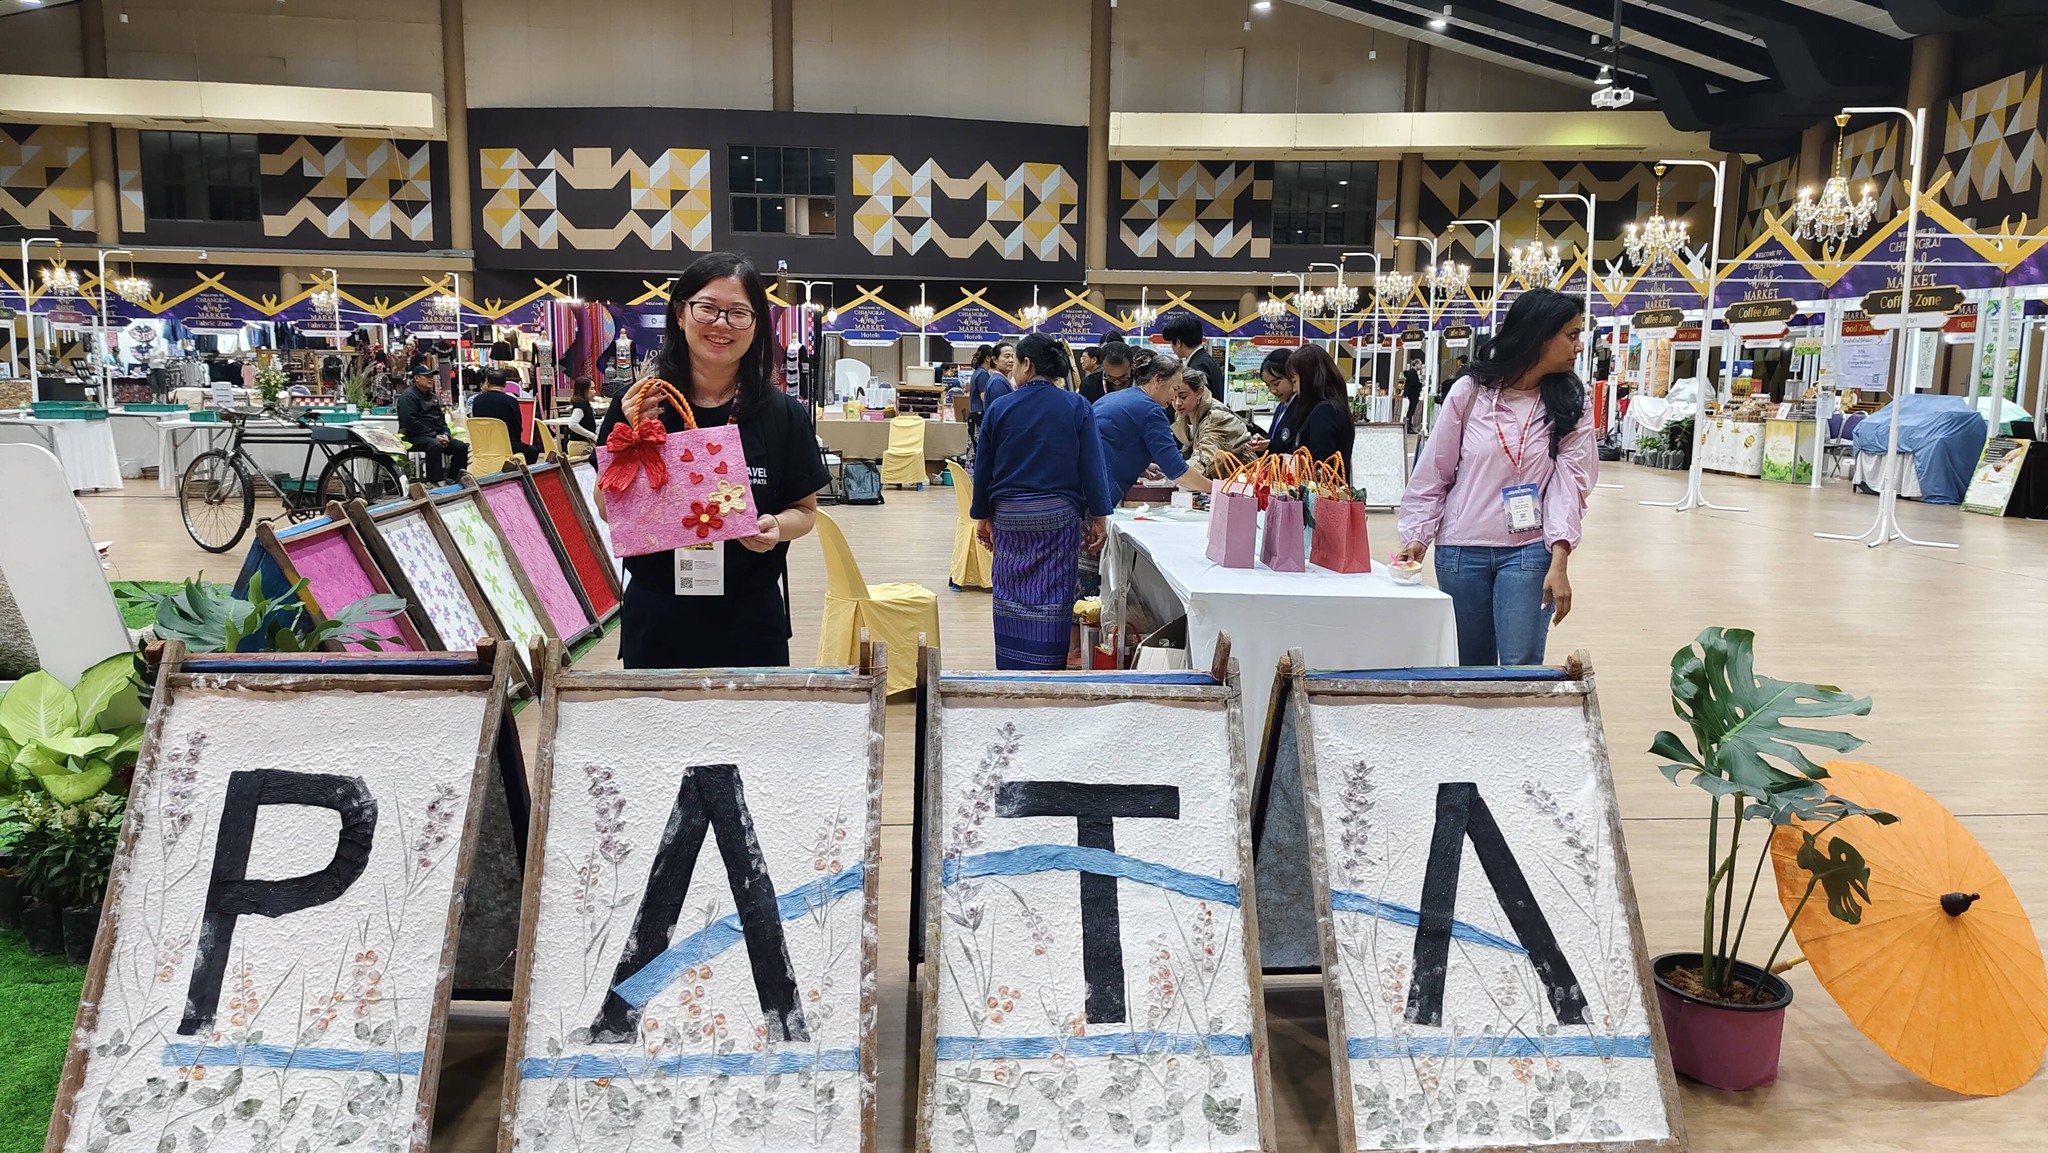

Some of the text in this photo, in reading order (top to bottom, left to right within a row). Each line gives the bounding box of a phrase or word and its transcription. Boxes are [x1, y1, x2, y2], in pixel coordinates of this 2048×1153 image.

[1888, 237, 1942, 253] CHINGRAI
[1755, 250, 1776, 258] WELCOME
[1886, 273, 1938, 289] MAKET
[1743, 288, 1780, 302] MARKET
[1880, 292, 1942, 309] Coffe Zone
[1644, 298, 1671, 310] MARKET
[1738, 305, 1782, 319] Coffee Zone
[1641, 313, 1673, 325] Coffee Zone
[1957, 318, 1976, 329] Food
[854, 323, 885, 331] MARKET
[1843, 324, 1857, 333] Food
